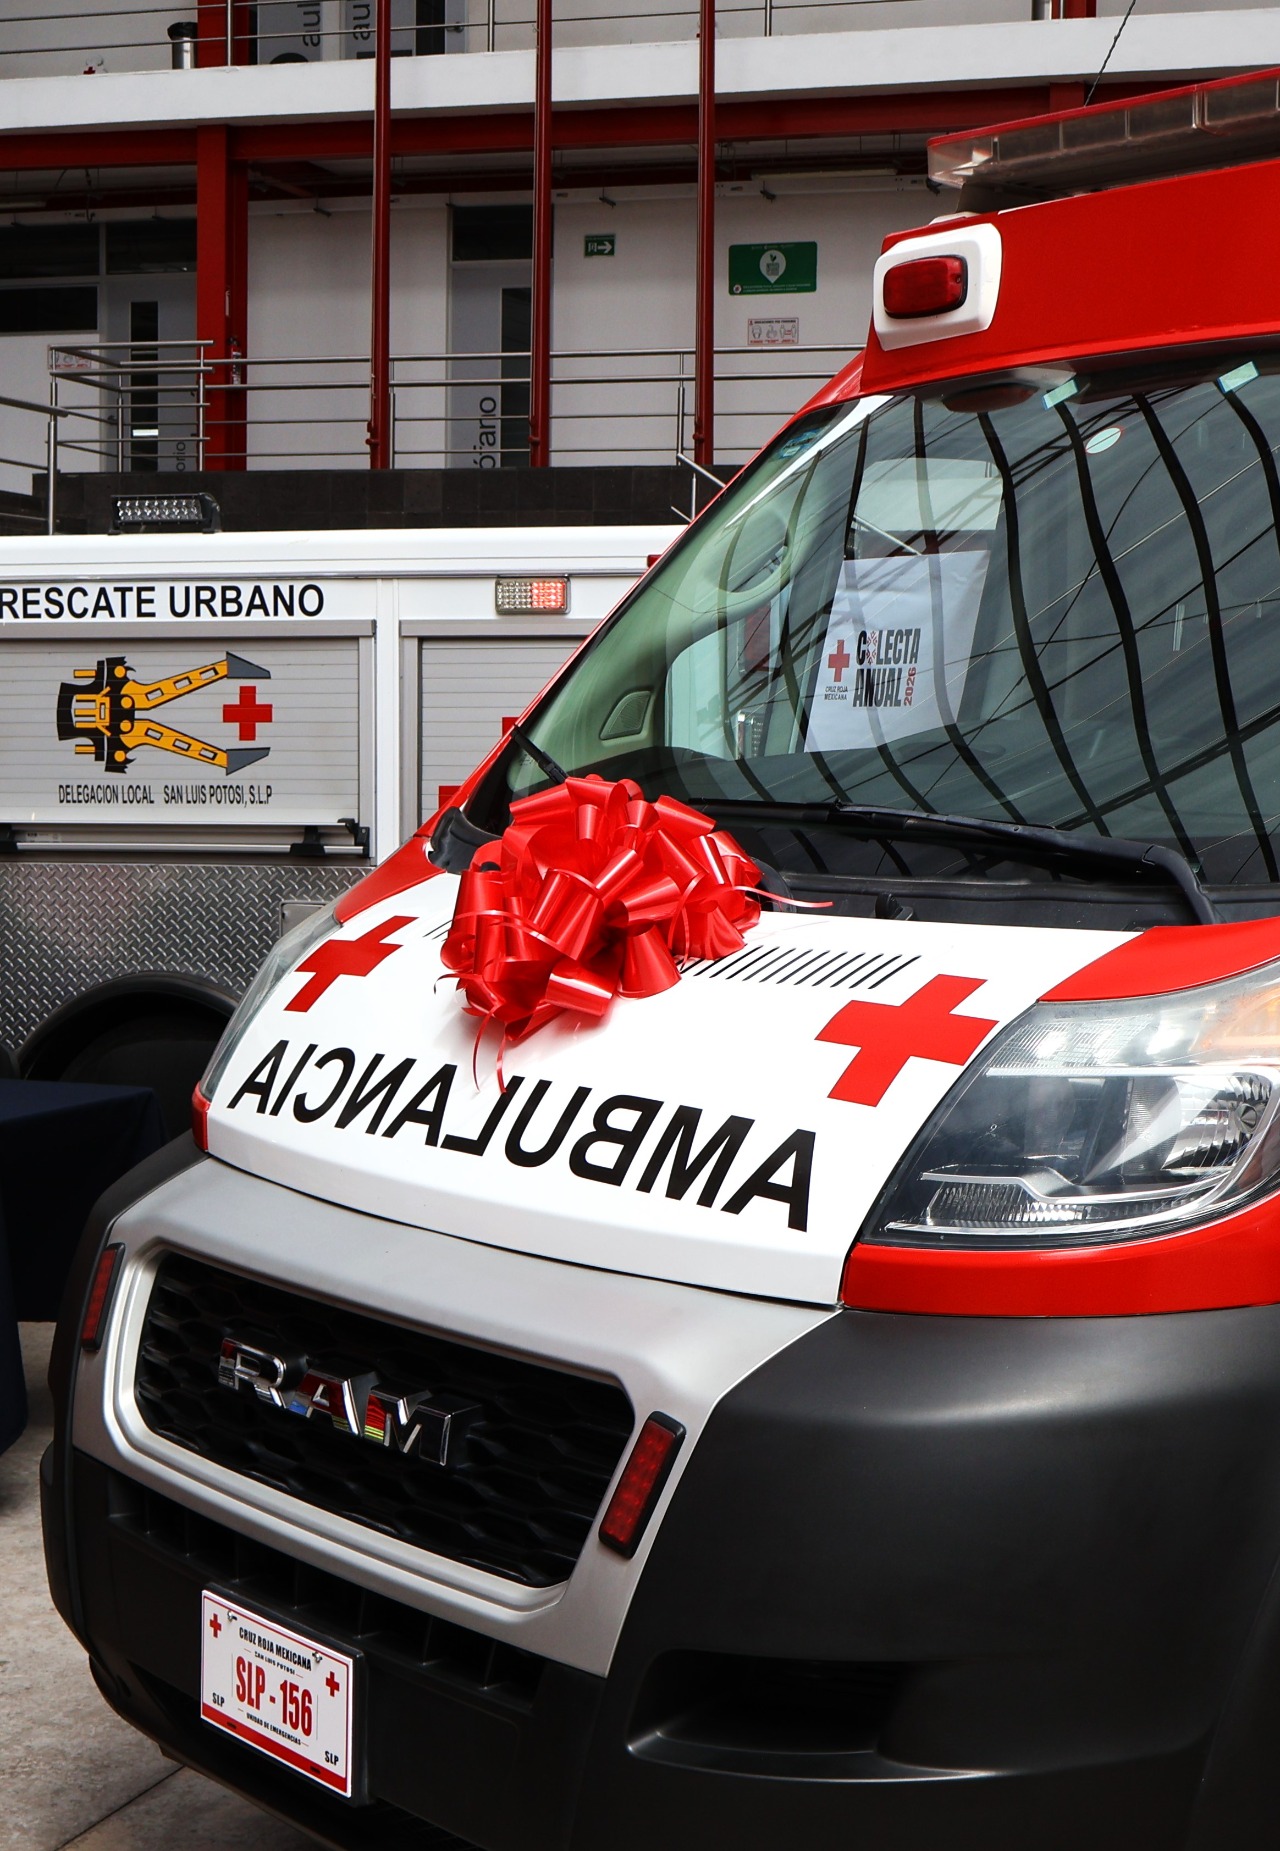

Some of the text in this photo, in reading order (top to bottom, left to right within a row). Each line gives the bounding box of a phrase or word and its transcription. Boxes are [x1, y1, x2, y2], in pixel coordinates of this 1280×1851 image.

[0, 584, 325, 620] RESCATE URBANO
[852, 667, 903, 708] ANUAL
[904, 666, 917, 706] 2026
[58, 784, 119, 804] DELEGACION
[121, 784, 155, 804] LOCAL
[163, 784, 183, 804] SAN
[185, 784, 207, 804] LUIS
[217, 1337, 453, 1467] RAM
[239, 1626, 312, 1672] CRUZ ROJA MEXICANA
[264, 1656, 276, 1666] LUIS
[212, 1692, 225, 1707] SLP
[235, 1656, 266, 1711] SLP
[280, 1679, 313, 1738] 156
[246, 1712, 302, 1746] UNIDAD DE EMERGENCIAS
[324, 1750, 339, 1766] SLP
